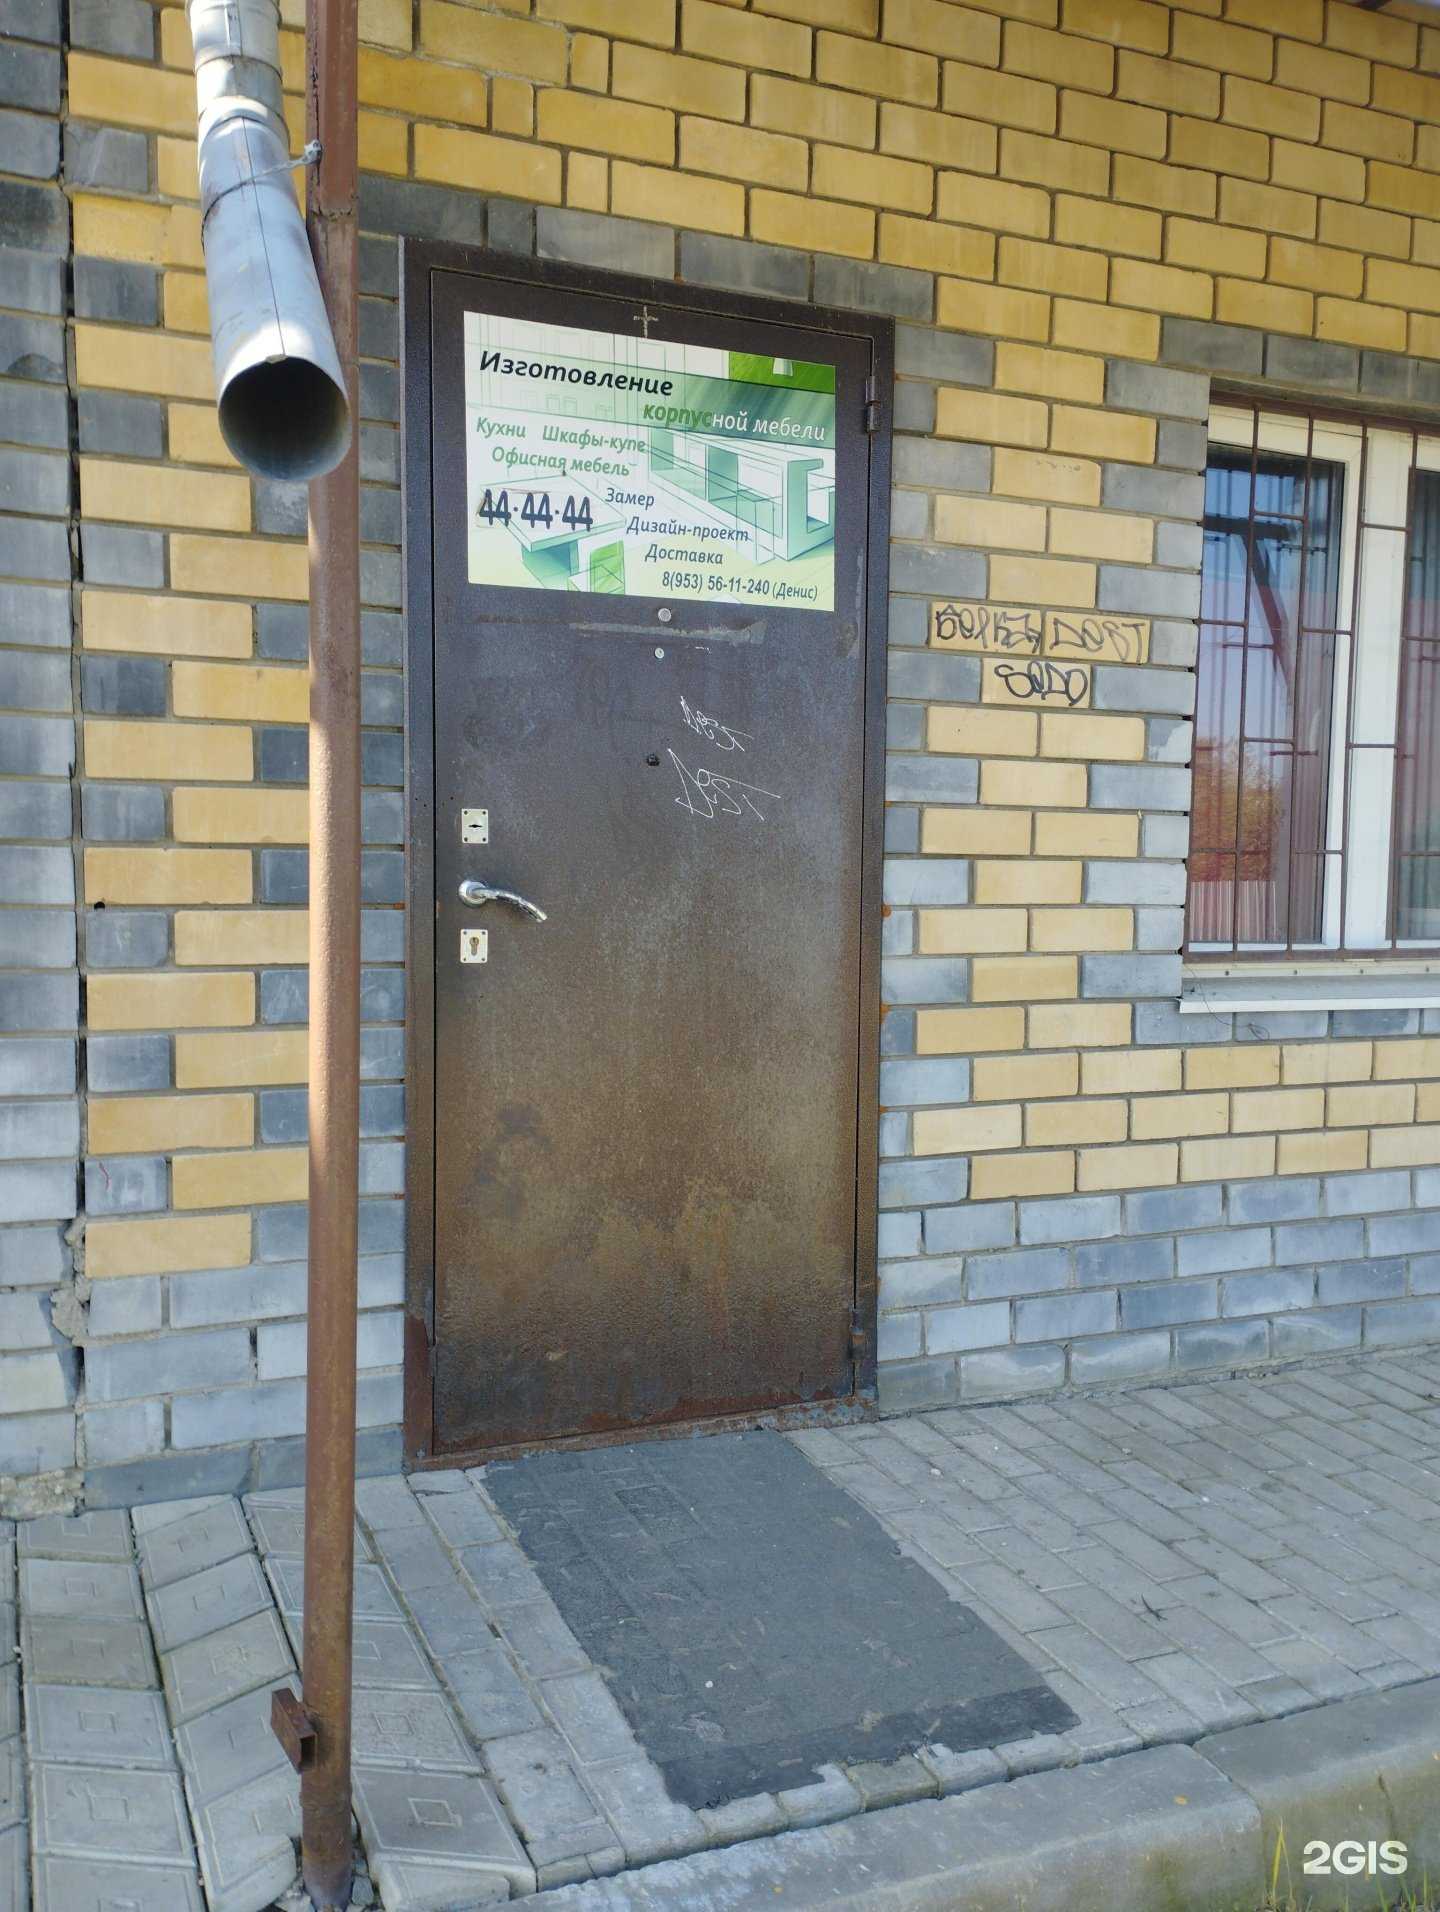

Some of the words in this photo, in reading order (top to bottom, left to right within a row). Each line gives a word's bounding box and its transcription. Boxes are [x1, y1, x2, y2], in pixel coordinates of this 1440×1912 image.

[480, 350, 674, 397] Изготовление
[476, 416, 527, 439] Кухни
[542, 424, 647, 454] Шкафы-купе
[643, 402, 748, 433] корпусной
[752, 416, 826, 442] мебели
[491, 446, 568, 469] Офисная
[569, 456, 631, 478] мебель
[605, 487, 655, 509] Замер
[626, 515, 750, 543] Дизайн-проект
[644, 543, 724, 566] Доставка
[661, 570, 703, 594] 8(953)
[707, 574, 771, 597] 56-11-240
[772, 581, 819, 602] (Денис)
